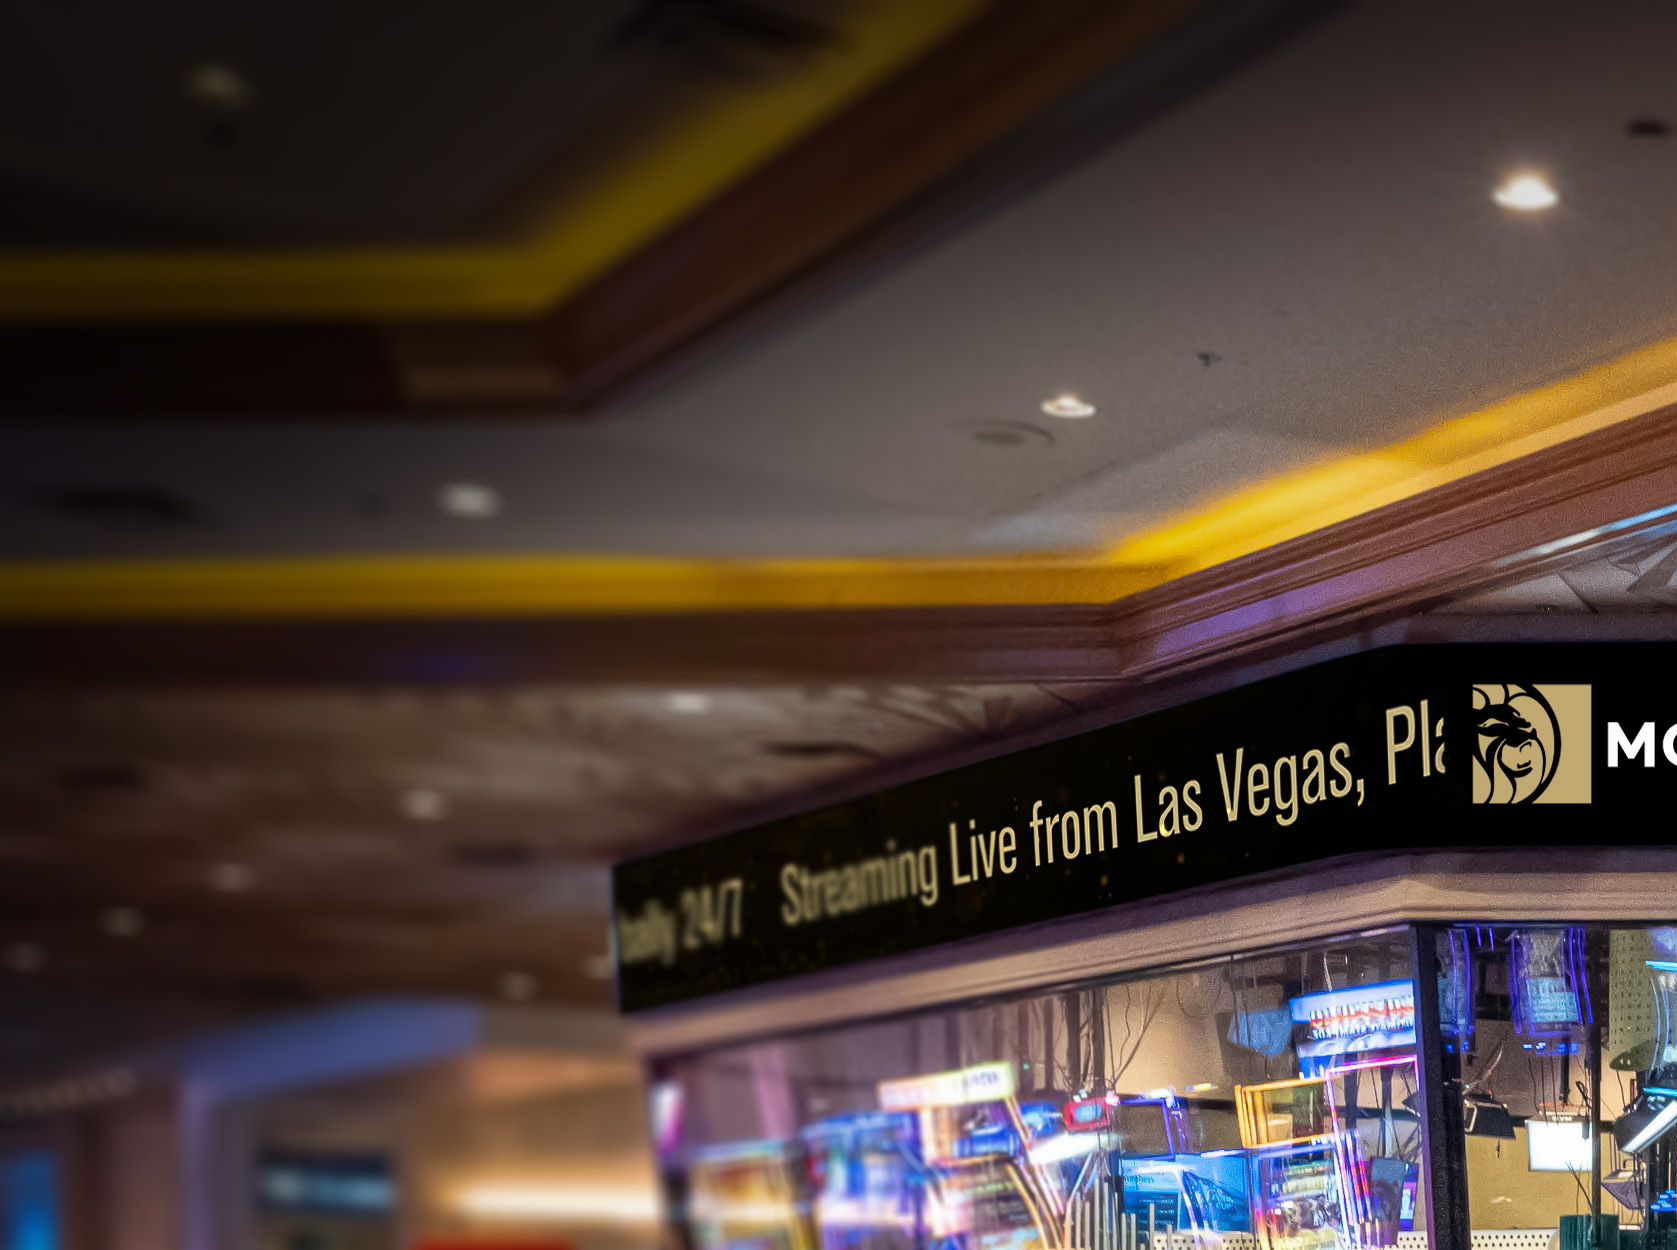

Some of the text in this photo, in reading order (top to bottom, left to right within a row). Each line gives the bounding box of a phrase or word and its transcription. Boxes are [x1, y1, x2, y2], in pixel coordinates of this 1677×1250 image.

[681, 877, 744, 950] 24/7
[779, 838, 939, 926] Streaming
[948, 818, 1018, 886] Live
[1028, 799, 1119, 867] from
[1132, 773, 1204, 844] Las
[1215, 740, 1366, 827] Vegas,
